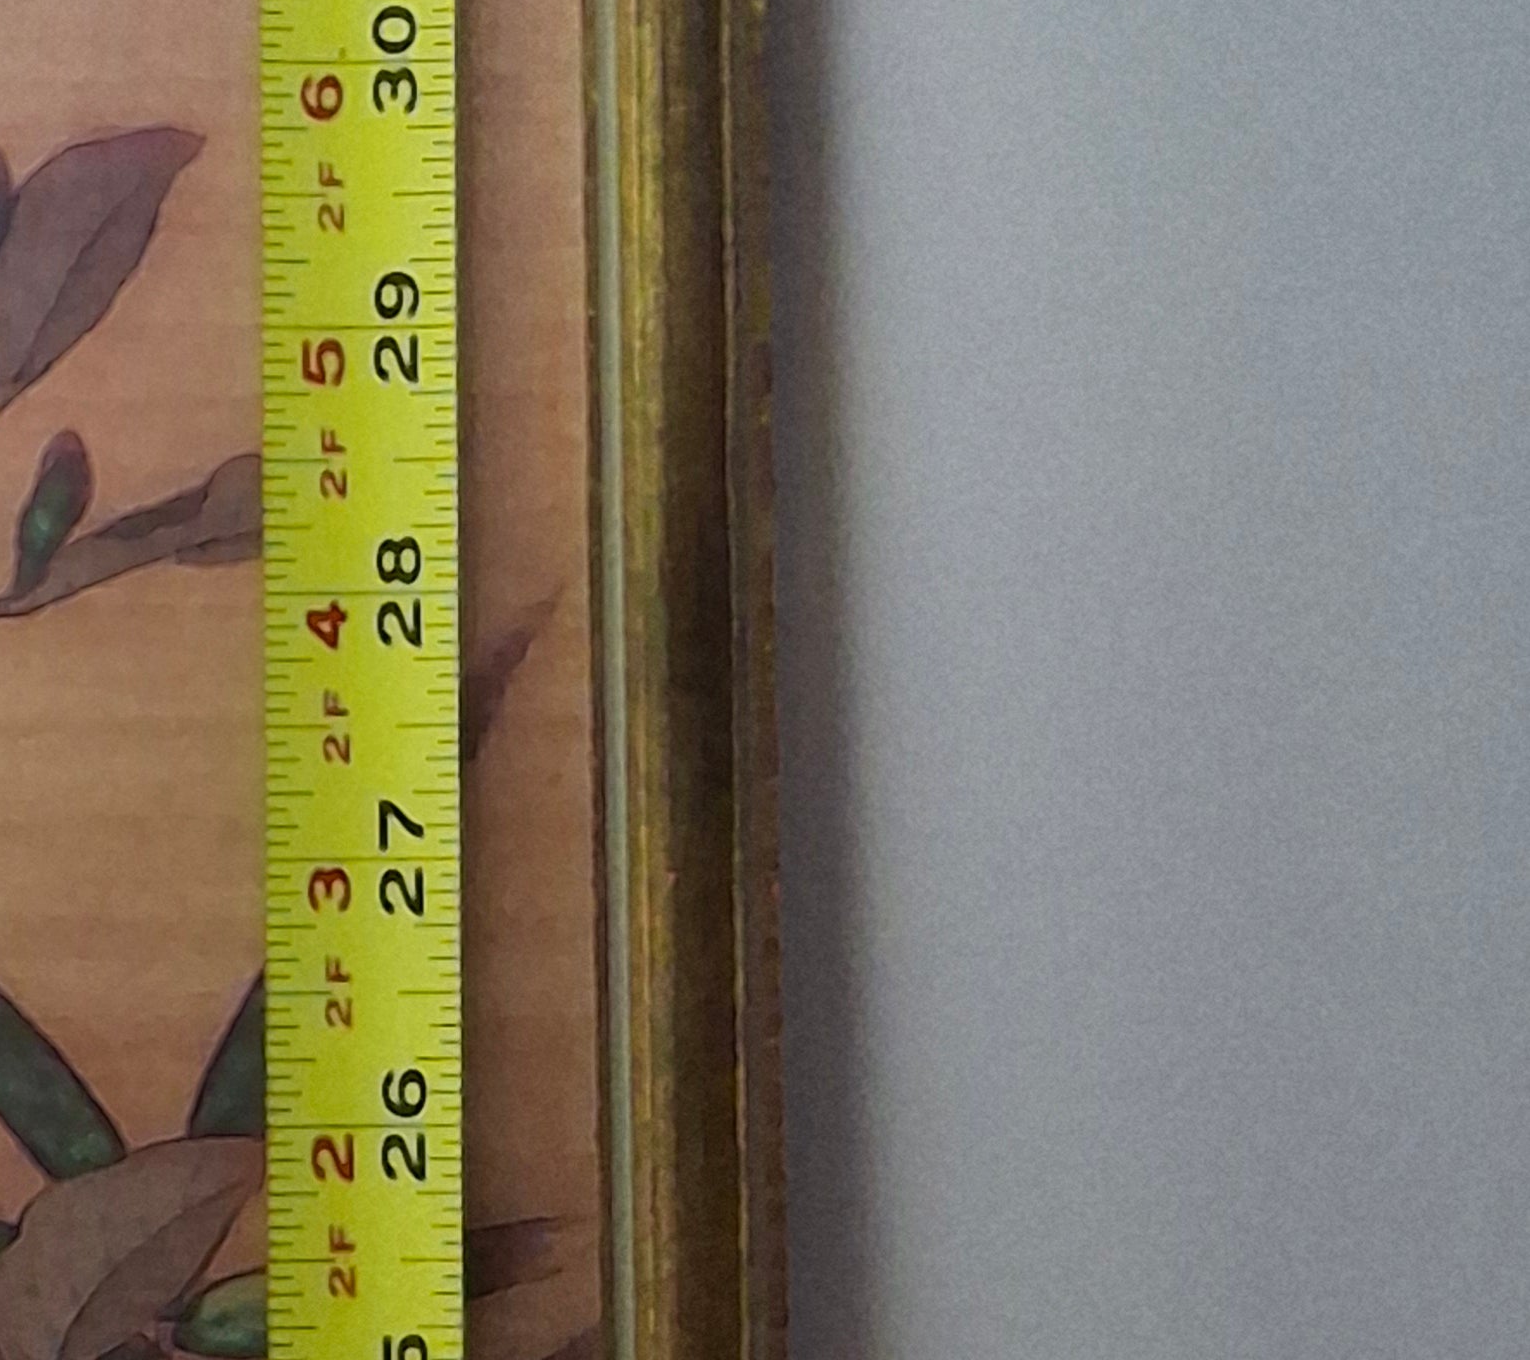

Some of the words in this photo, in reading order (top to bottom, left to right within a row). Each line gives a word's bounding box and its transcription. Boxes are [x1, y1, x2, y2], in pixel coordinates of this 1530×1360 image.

[300, 74, 344, 121] 6
[372, 6, 419, 115] 30
[302, 338, 345, 388] 5
[374, 271, 420, 384] 29
[305, 601, 347, 650] 4
[375, 536, 423, 648] 28
[308, 867, 352, 913] 3
[378, 798, 425, 918] 27
[310, 1133, 355, 1182] 2
[381, 1067, 427, 1182] 26
